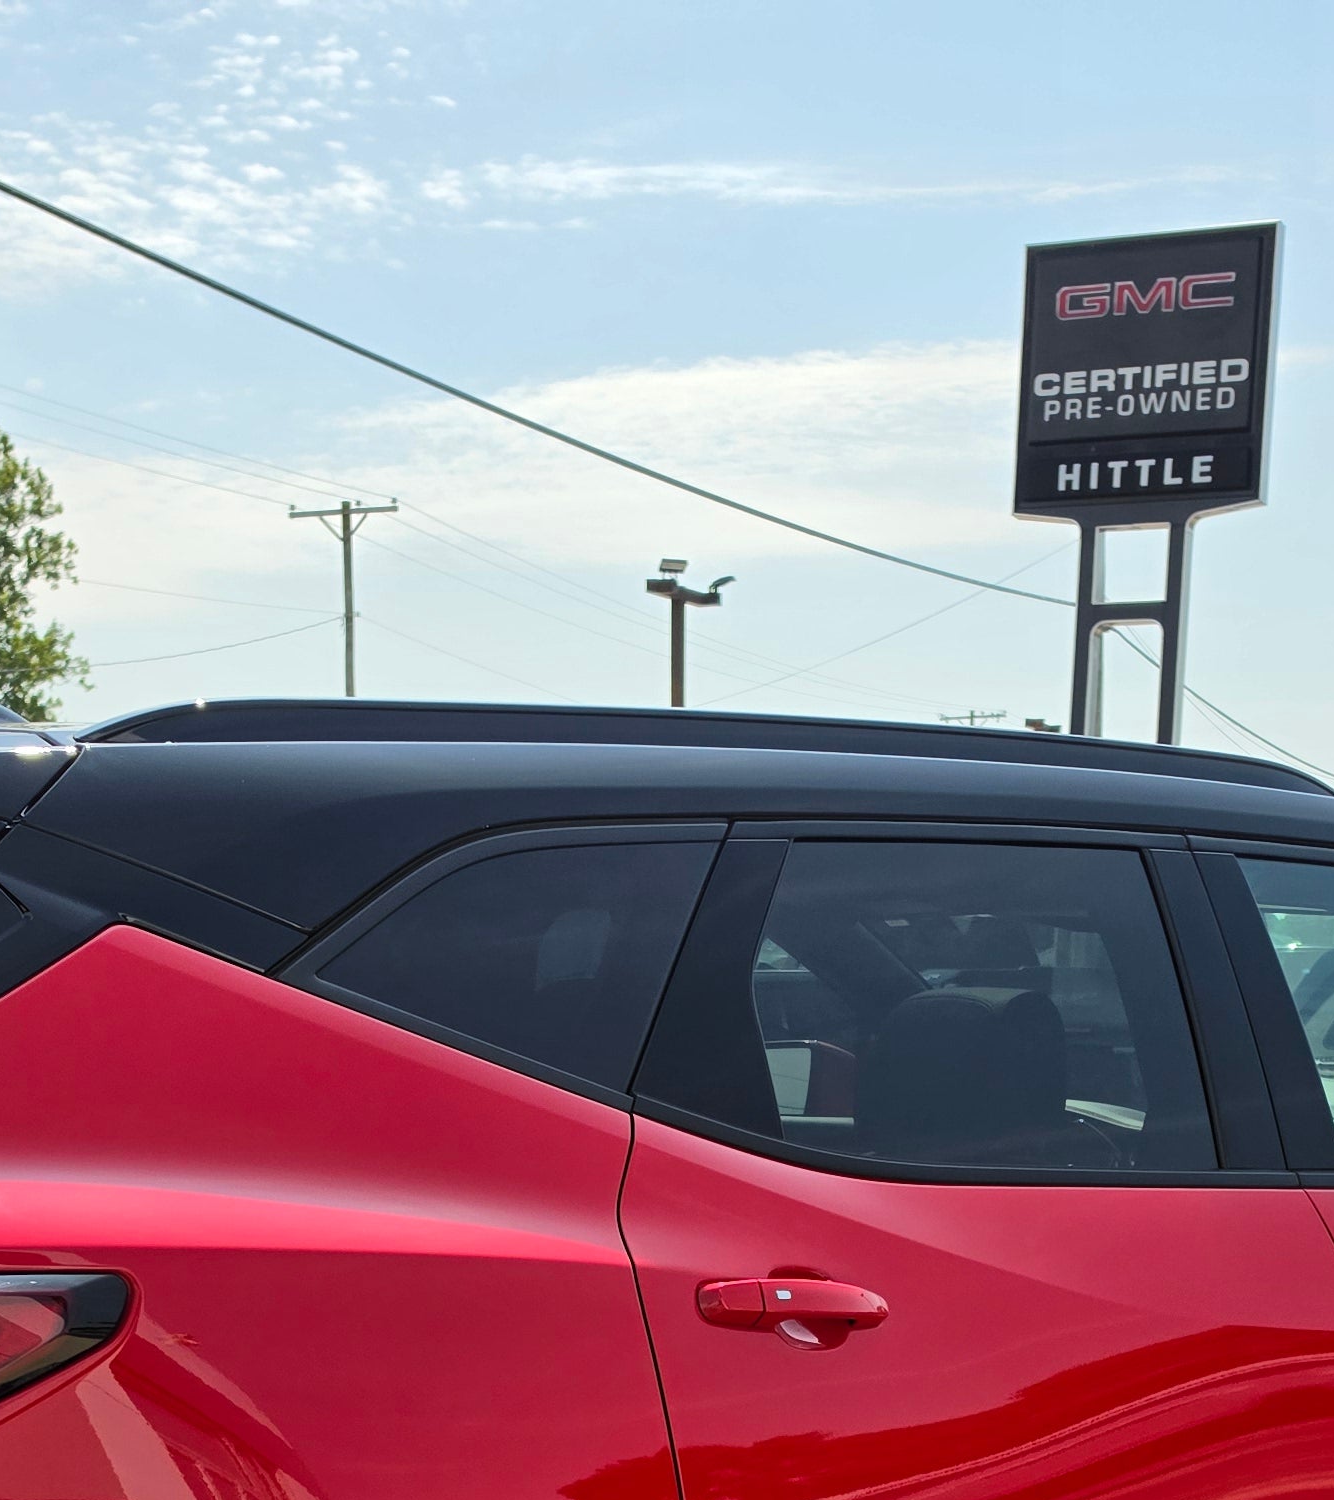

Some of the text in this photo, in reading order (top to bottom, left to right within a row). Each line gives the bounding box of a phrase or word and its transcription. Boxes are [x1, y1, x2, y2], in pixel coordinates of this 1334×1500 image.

[1055, 271, 1236, 321] GMC
[1033, 358, 1250, 397] CERTIFIED
[1043, 386, 1236, 422] PRE-OWNED
[1056, 455, 1214, 491] HITTLE
